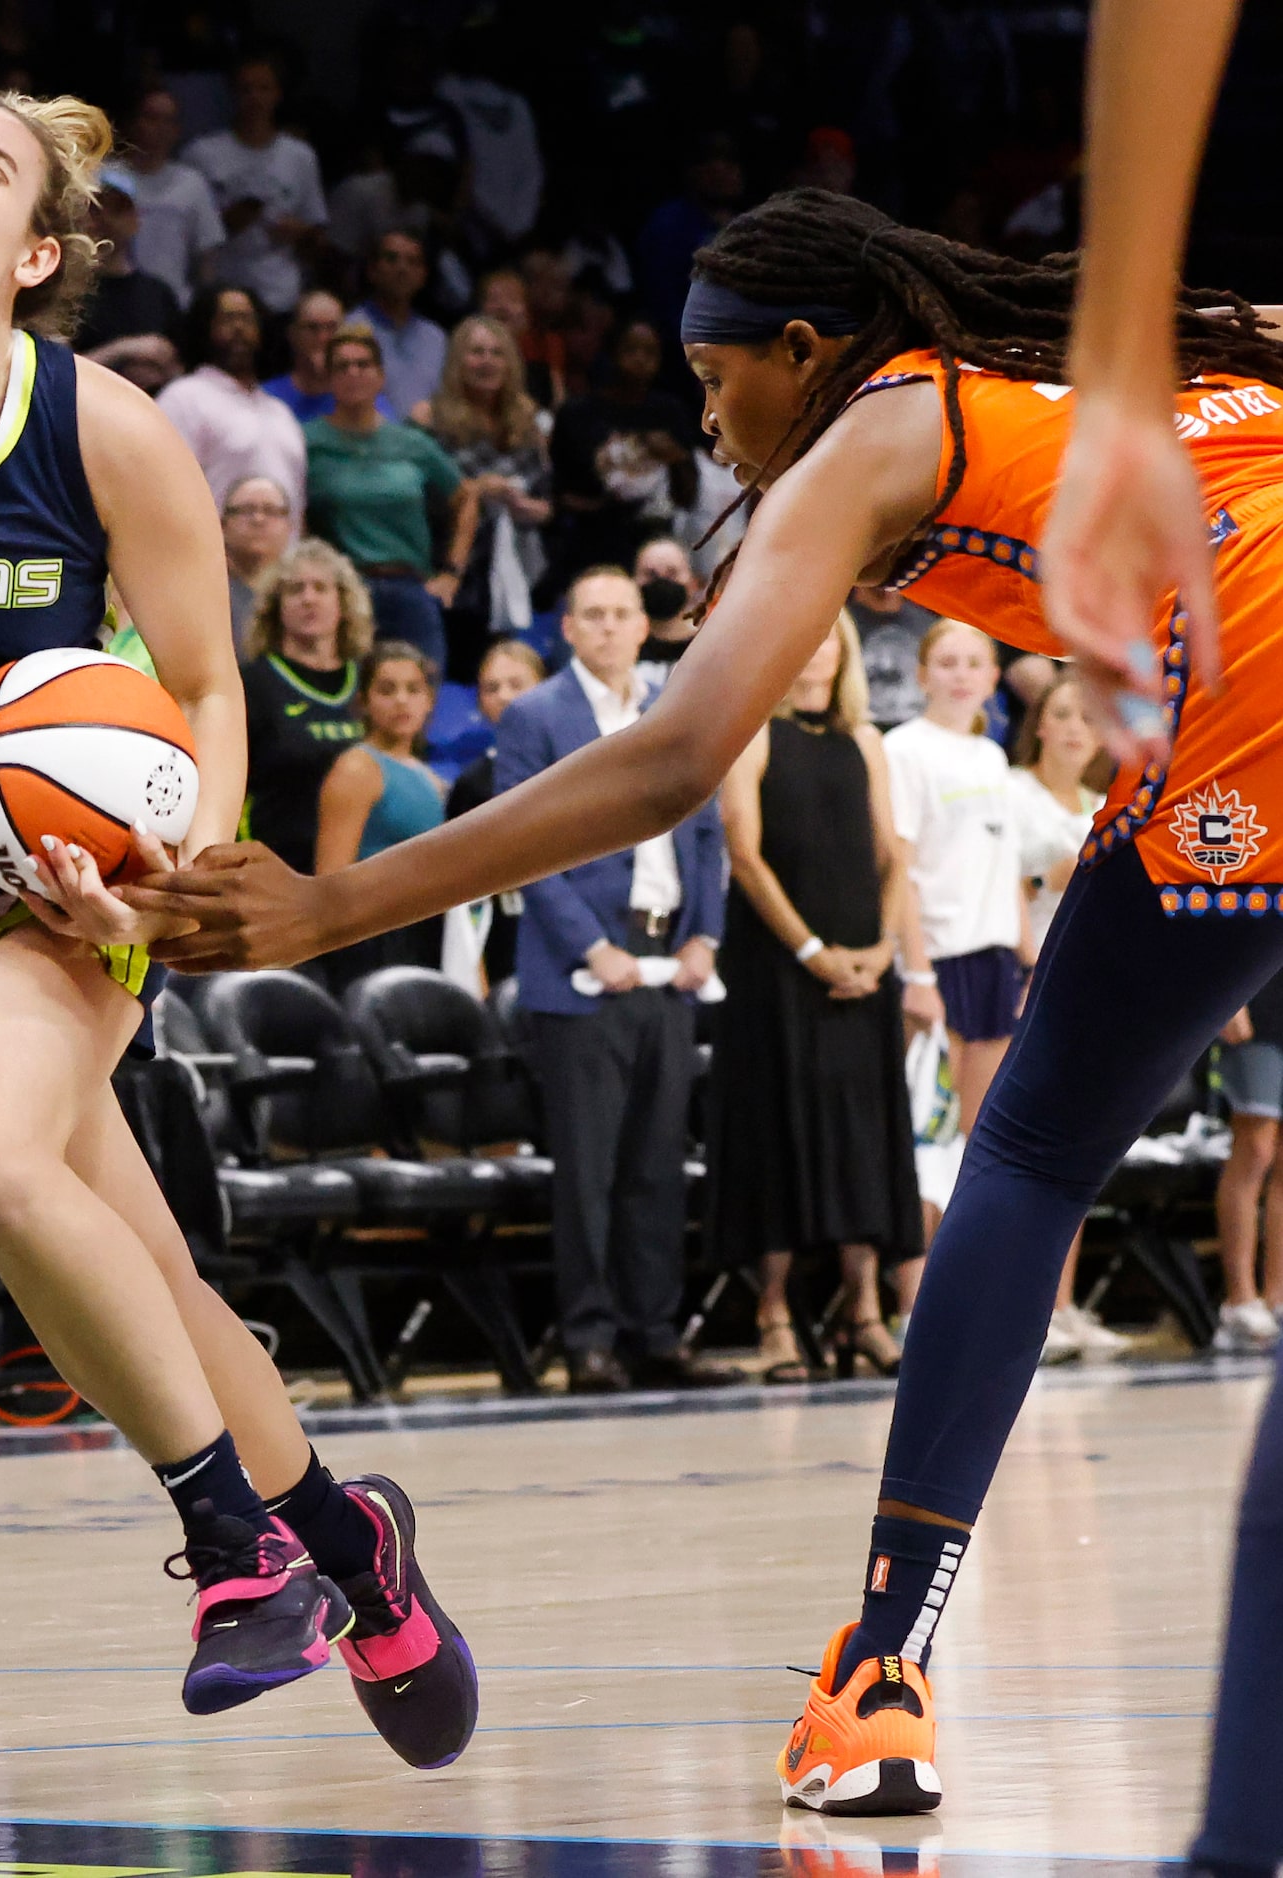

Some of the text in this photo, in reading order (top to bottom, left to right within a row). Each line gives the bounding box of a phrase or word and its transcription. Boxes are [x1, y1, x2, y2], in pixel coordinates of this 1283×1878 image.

[1199, 387, 1282, 425] AT&T
[1199, 815, 1232, 845] C
[882, 1655, 903, 1684] EASY
